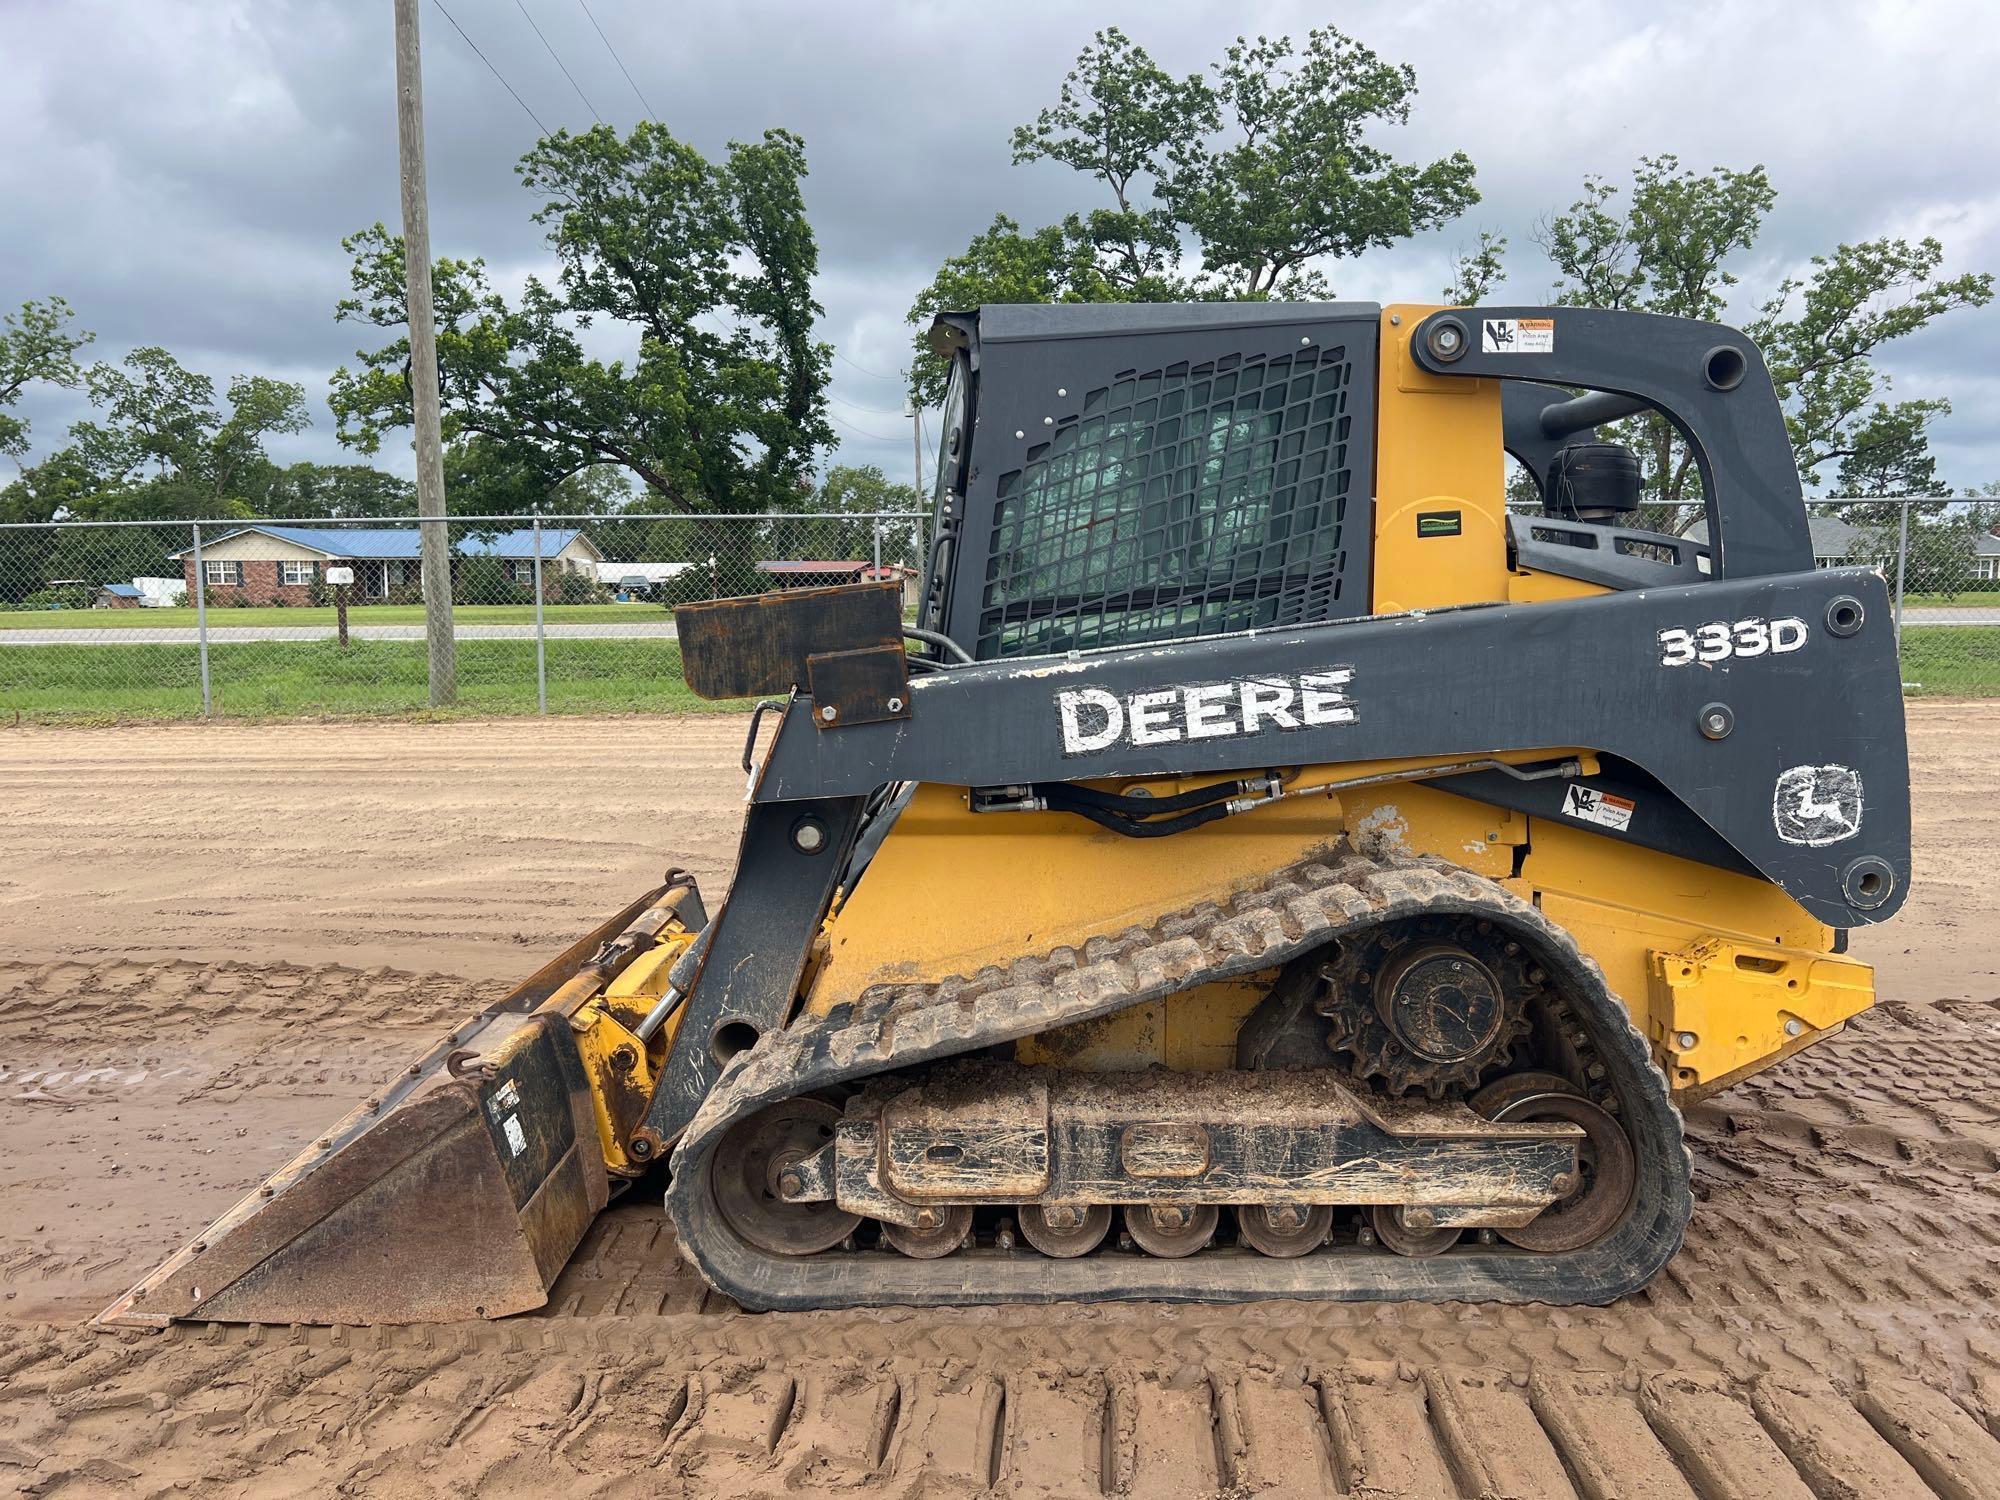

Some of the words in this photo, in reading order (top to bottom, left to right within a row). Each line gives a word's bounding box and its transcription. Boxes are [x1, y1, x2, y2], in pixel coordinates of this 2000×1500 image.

[1658, 616, 1808, 667] 333D
[1058, 669, 1355, 753] DEERE
[1608, 797, 1633, 808] WARNING
